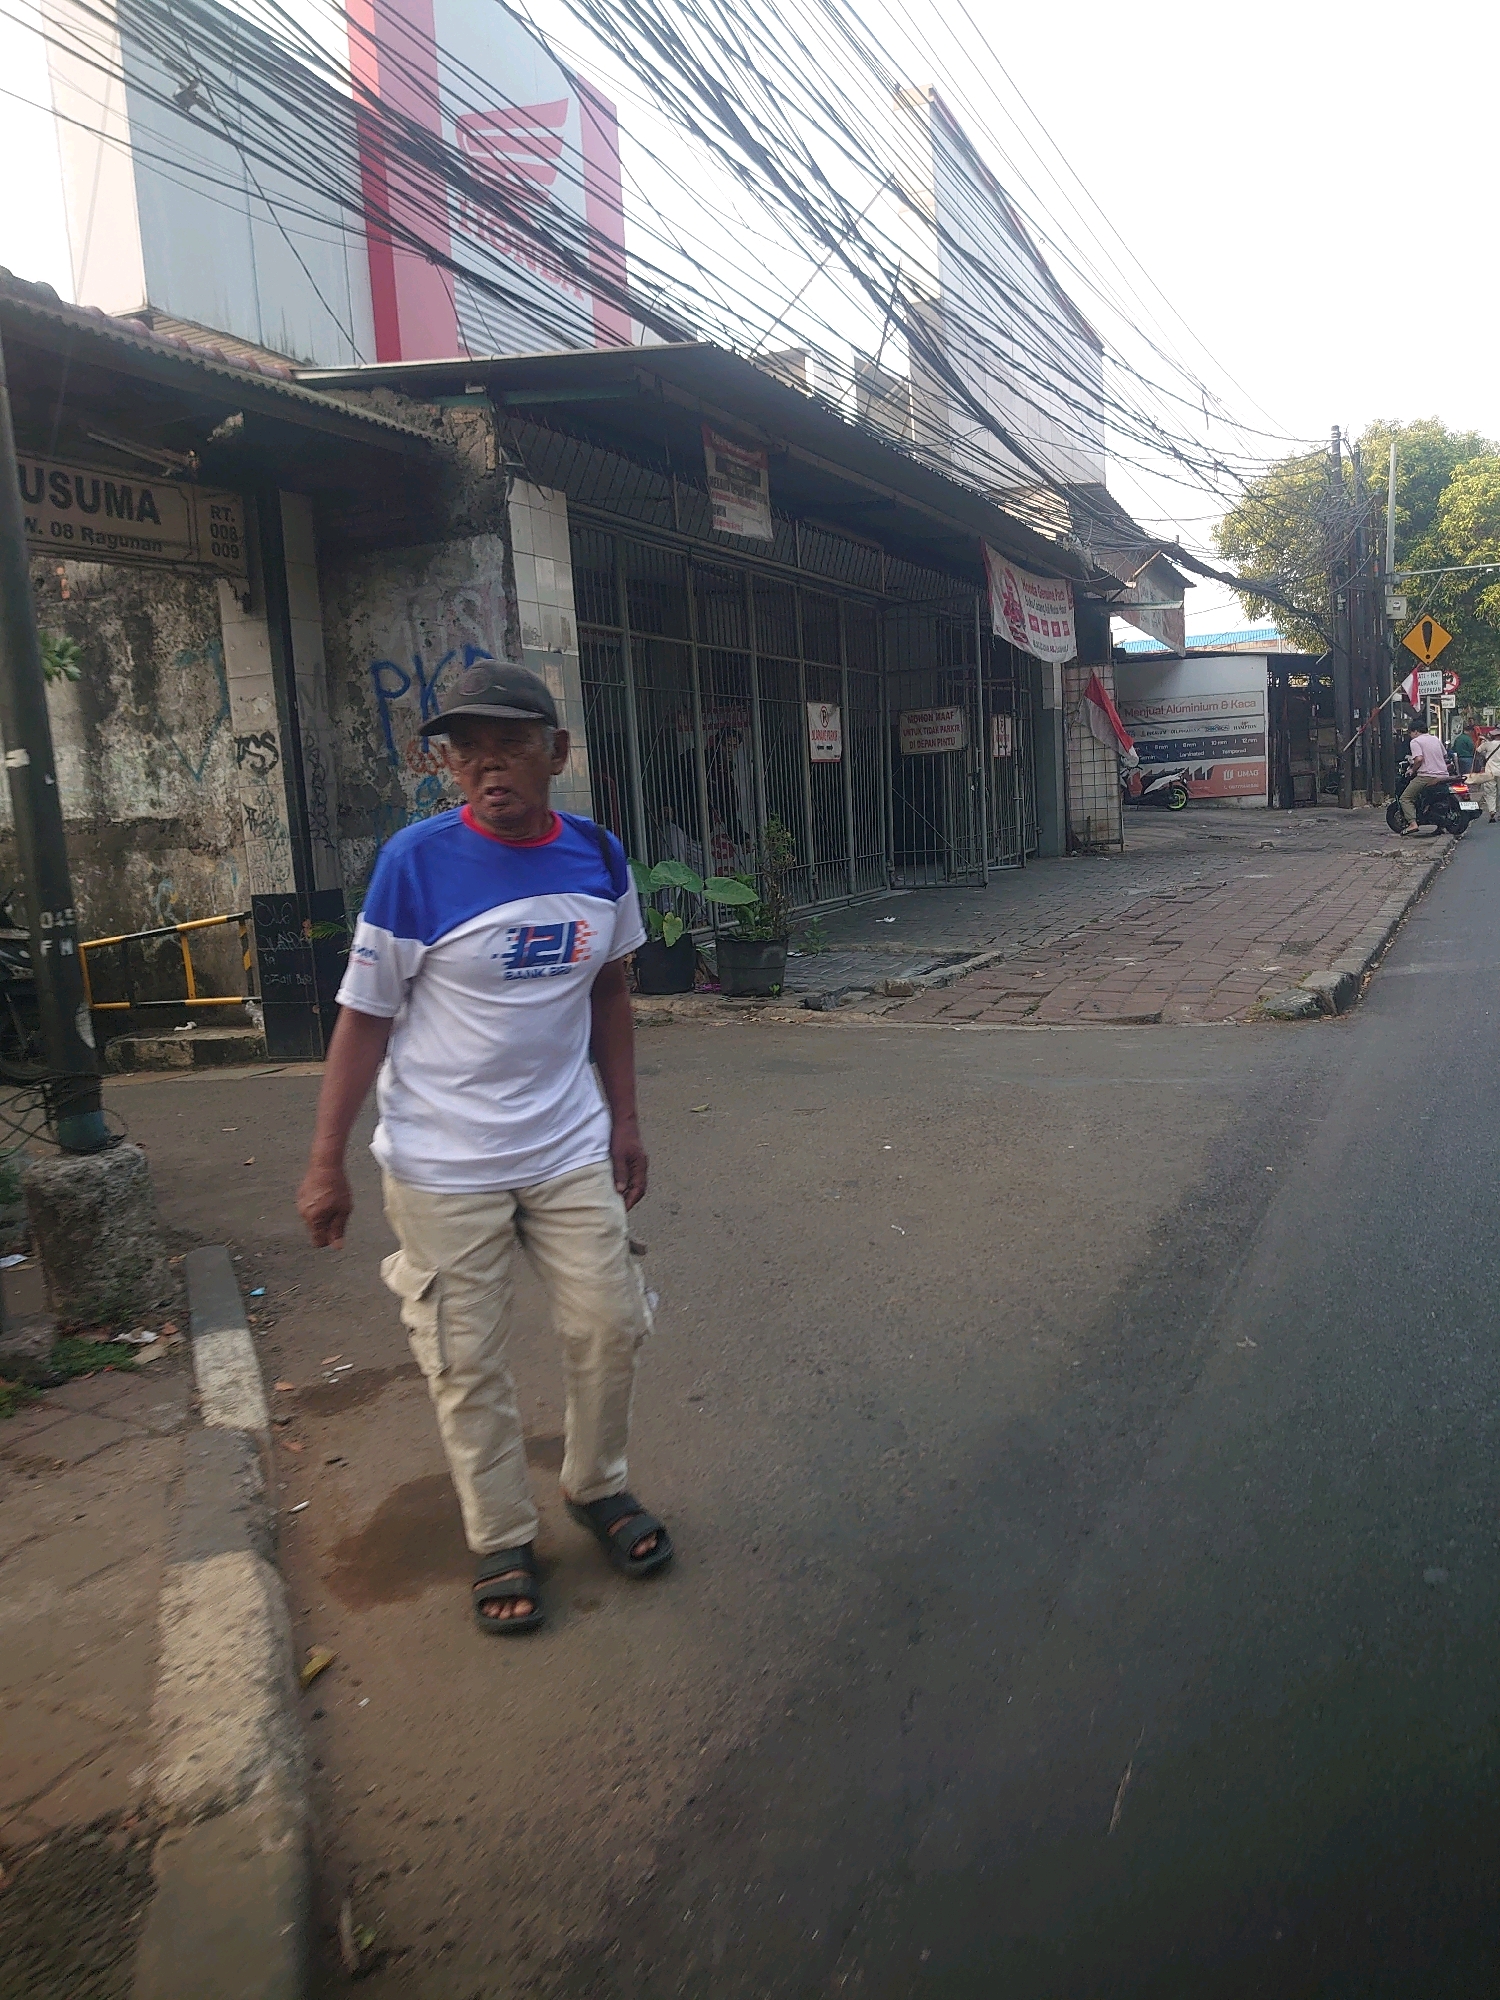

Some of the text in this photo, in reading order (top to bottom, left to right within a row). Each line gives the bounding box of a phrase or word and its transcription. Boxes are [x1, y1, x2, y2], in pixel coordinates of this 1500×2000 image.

[1124, 705, 1164, 719] Menjual
[1165, 702, 1219, 715] Aluminium
[1230, 700, 1256, 709] Kaca
[503, 968, 547, 981] BANK
